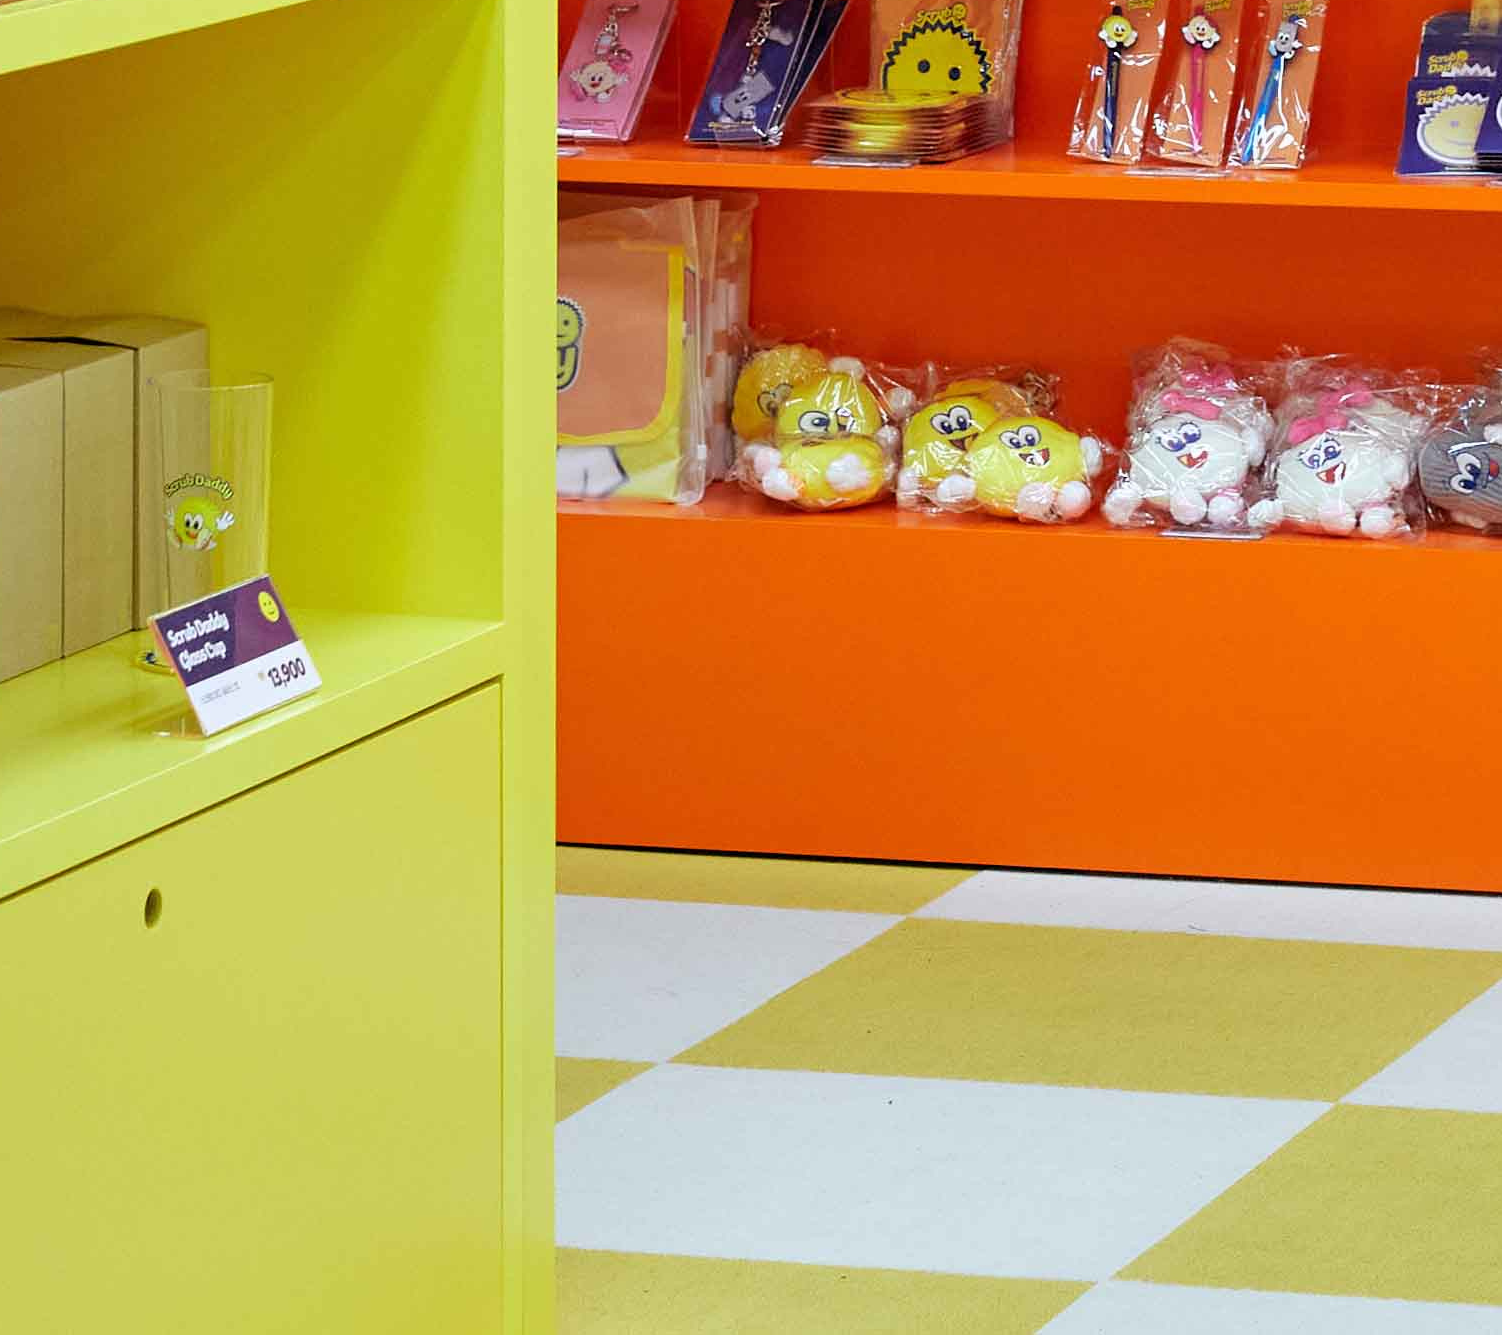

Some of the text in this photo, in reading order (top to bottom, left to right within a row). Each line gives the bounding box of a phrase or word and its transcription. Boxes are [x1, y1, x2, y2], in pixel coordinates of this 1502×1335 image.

[164, 473, 234, 500] Scrub Daddy
[167, 610, 230, 648] Scrub Daddy
[205, 639, 227, 664] Cup
[267, 656, 307, 690] 13,900
